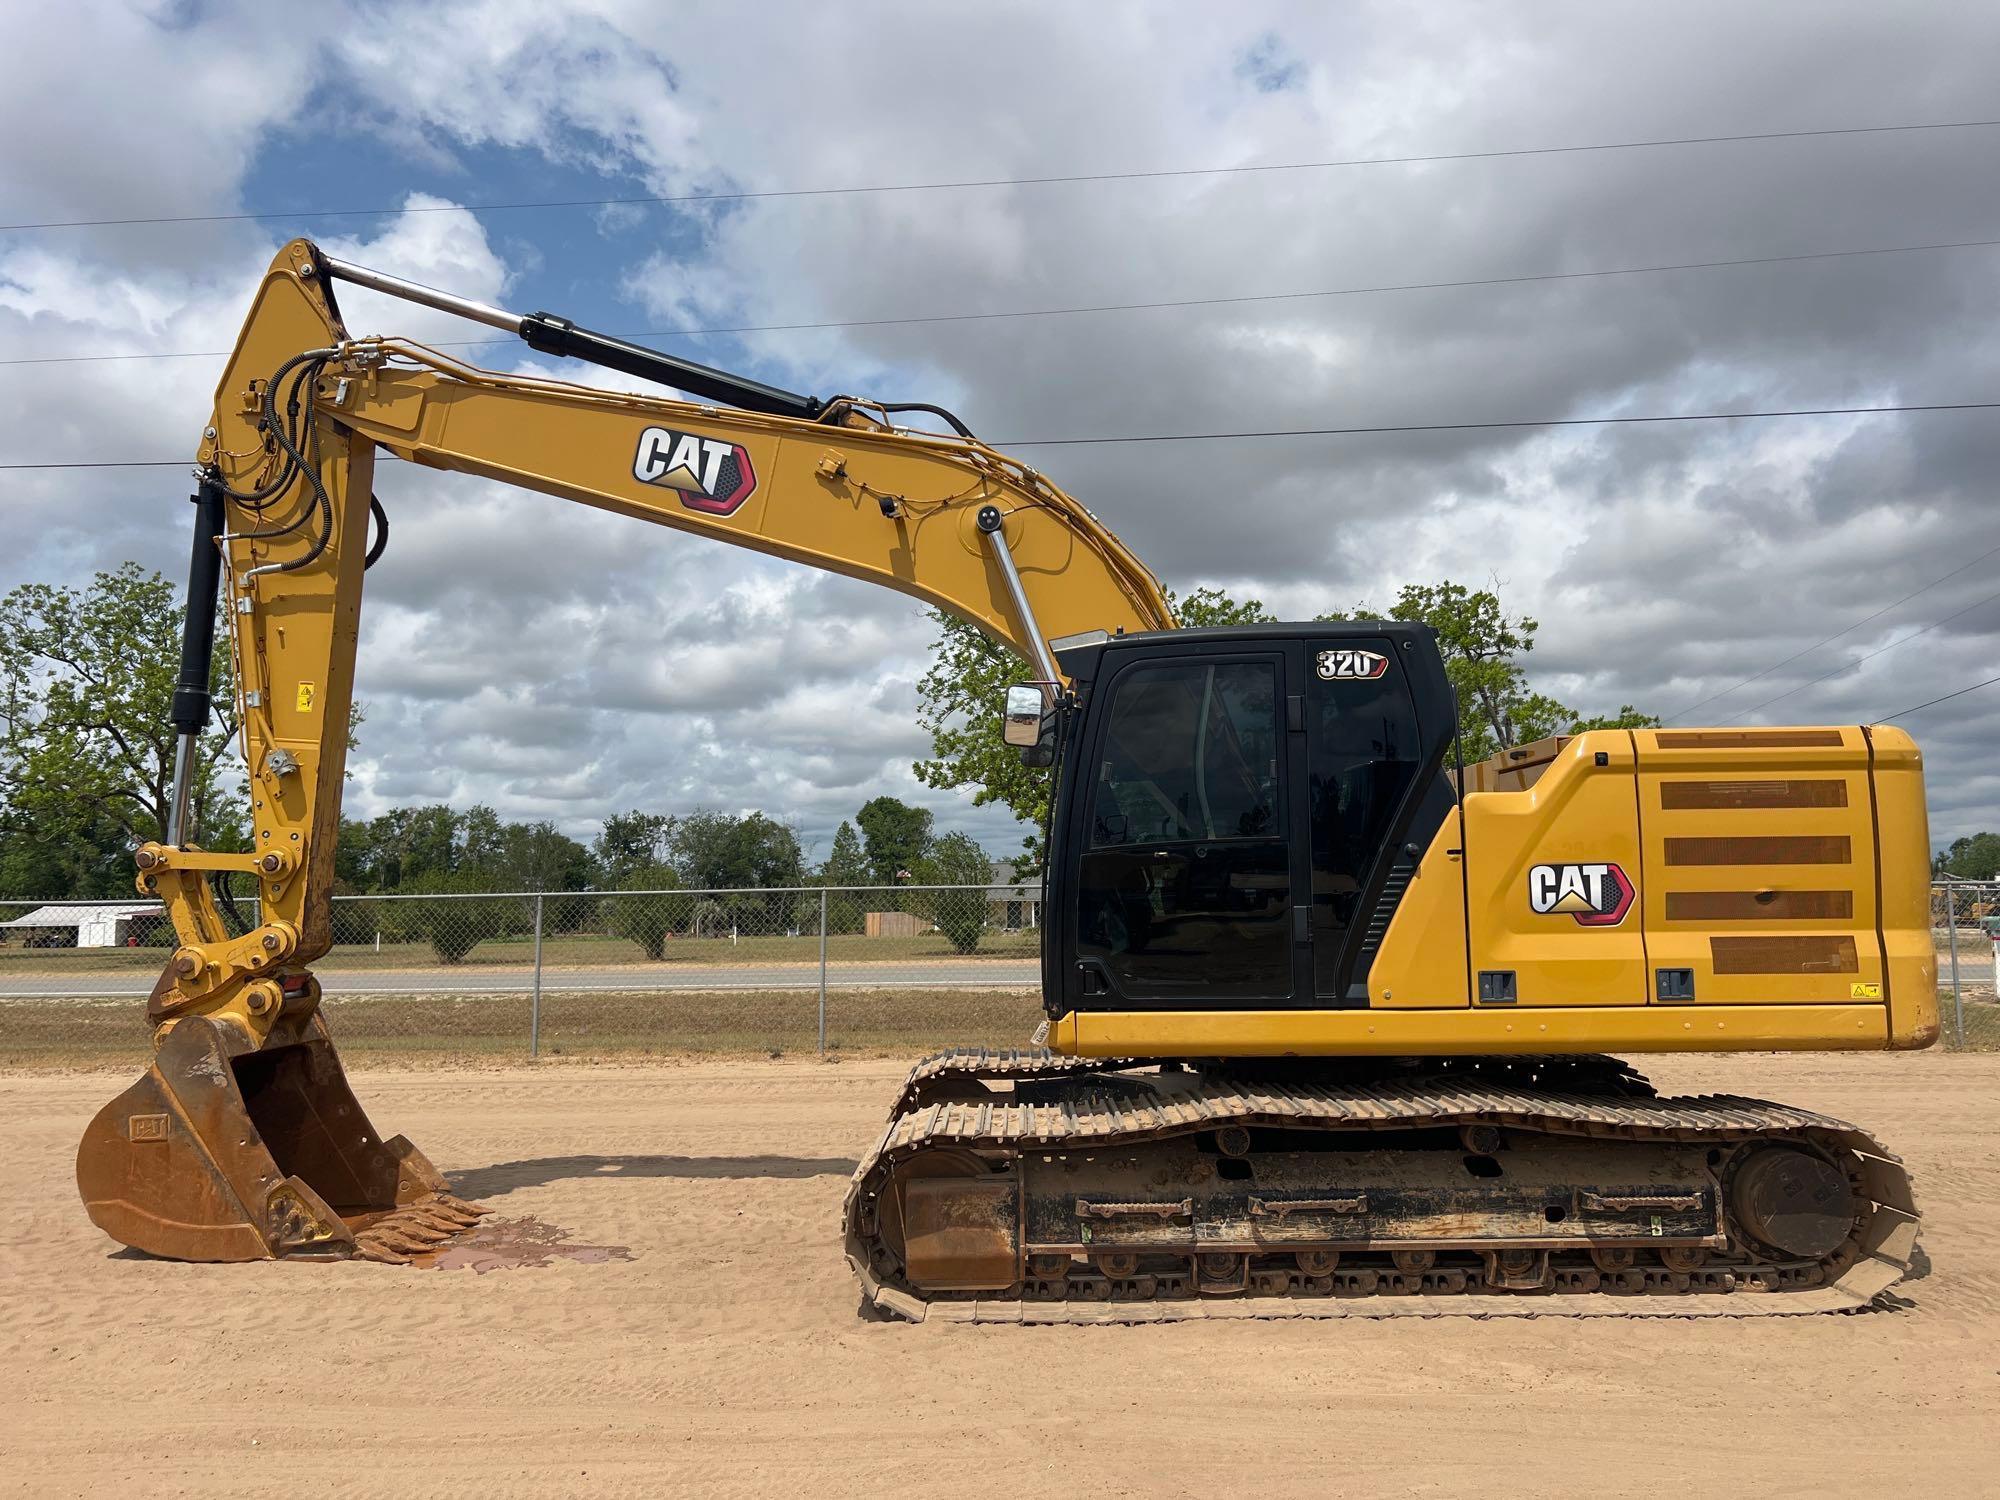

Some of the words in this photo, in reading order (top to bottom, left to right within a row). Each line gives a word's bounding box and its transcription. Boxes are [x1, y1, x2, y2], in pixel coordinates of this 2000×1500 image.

[634, 427, 733, 496] CAT
[1318, 651, 1371, 677] 320
[1530, 864, 1608, 913] CAT
